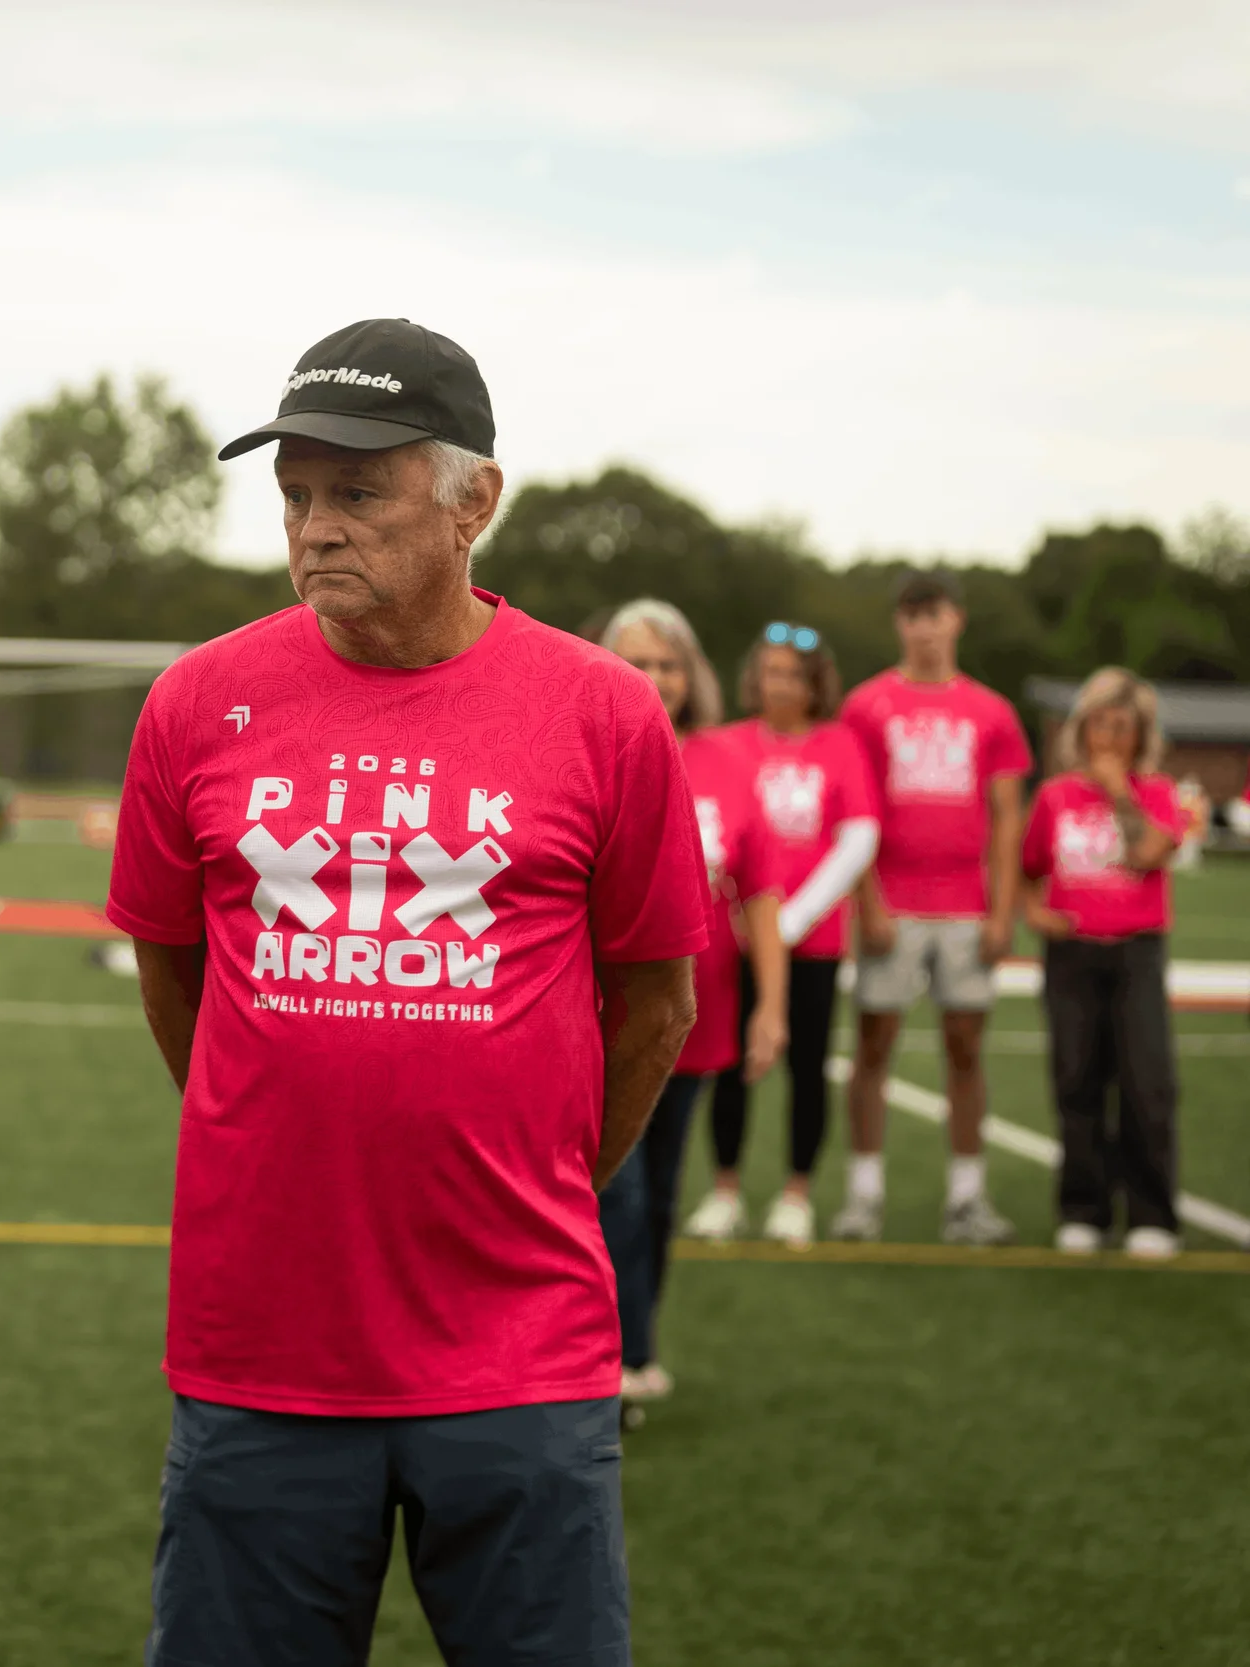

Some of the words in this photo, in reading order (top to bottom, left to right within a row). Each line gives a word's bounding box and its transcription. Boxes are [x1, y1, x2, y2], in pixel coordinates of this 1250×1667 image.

[329, 753, 436, 776] 2026
[251, 931, 500, 989] ARROW
[253, 992, 309, 1013] LOWELL
[391, 1002, 494, 1022] TOGETHER
